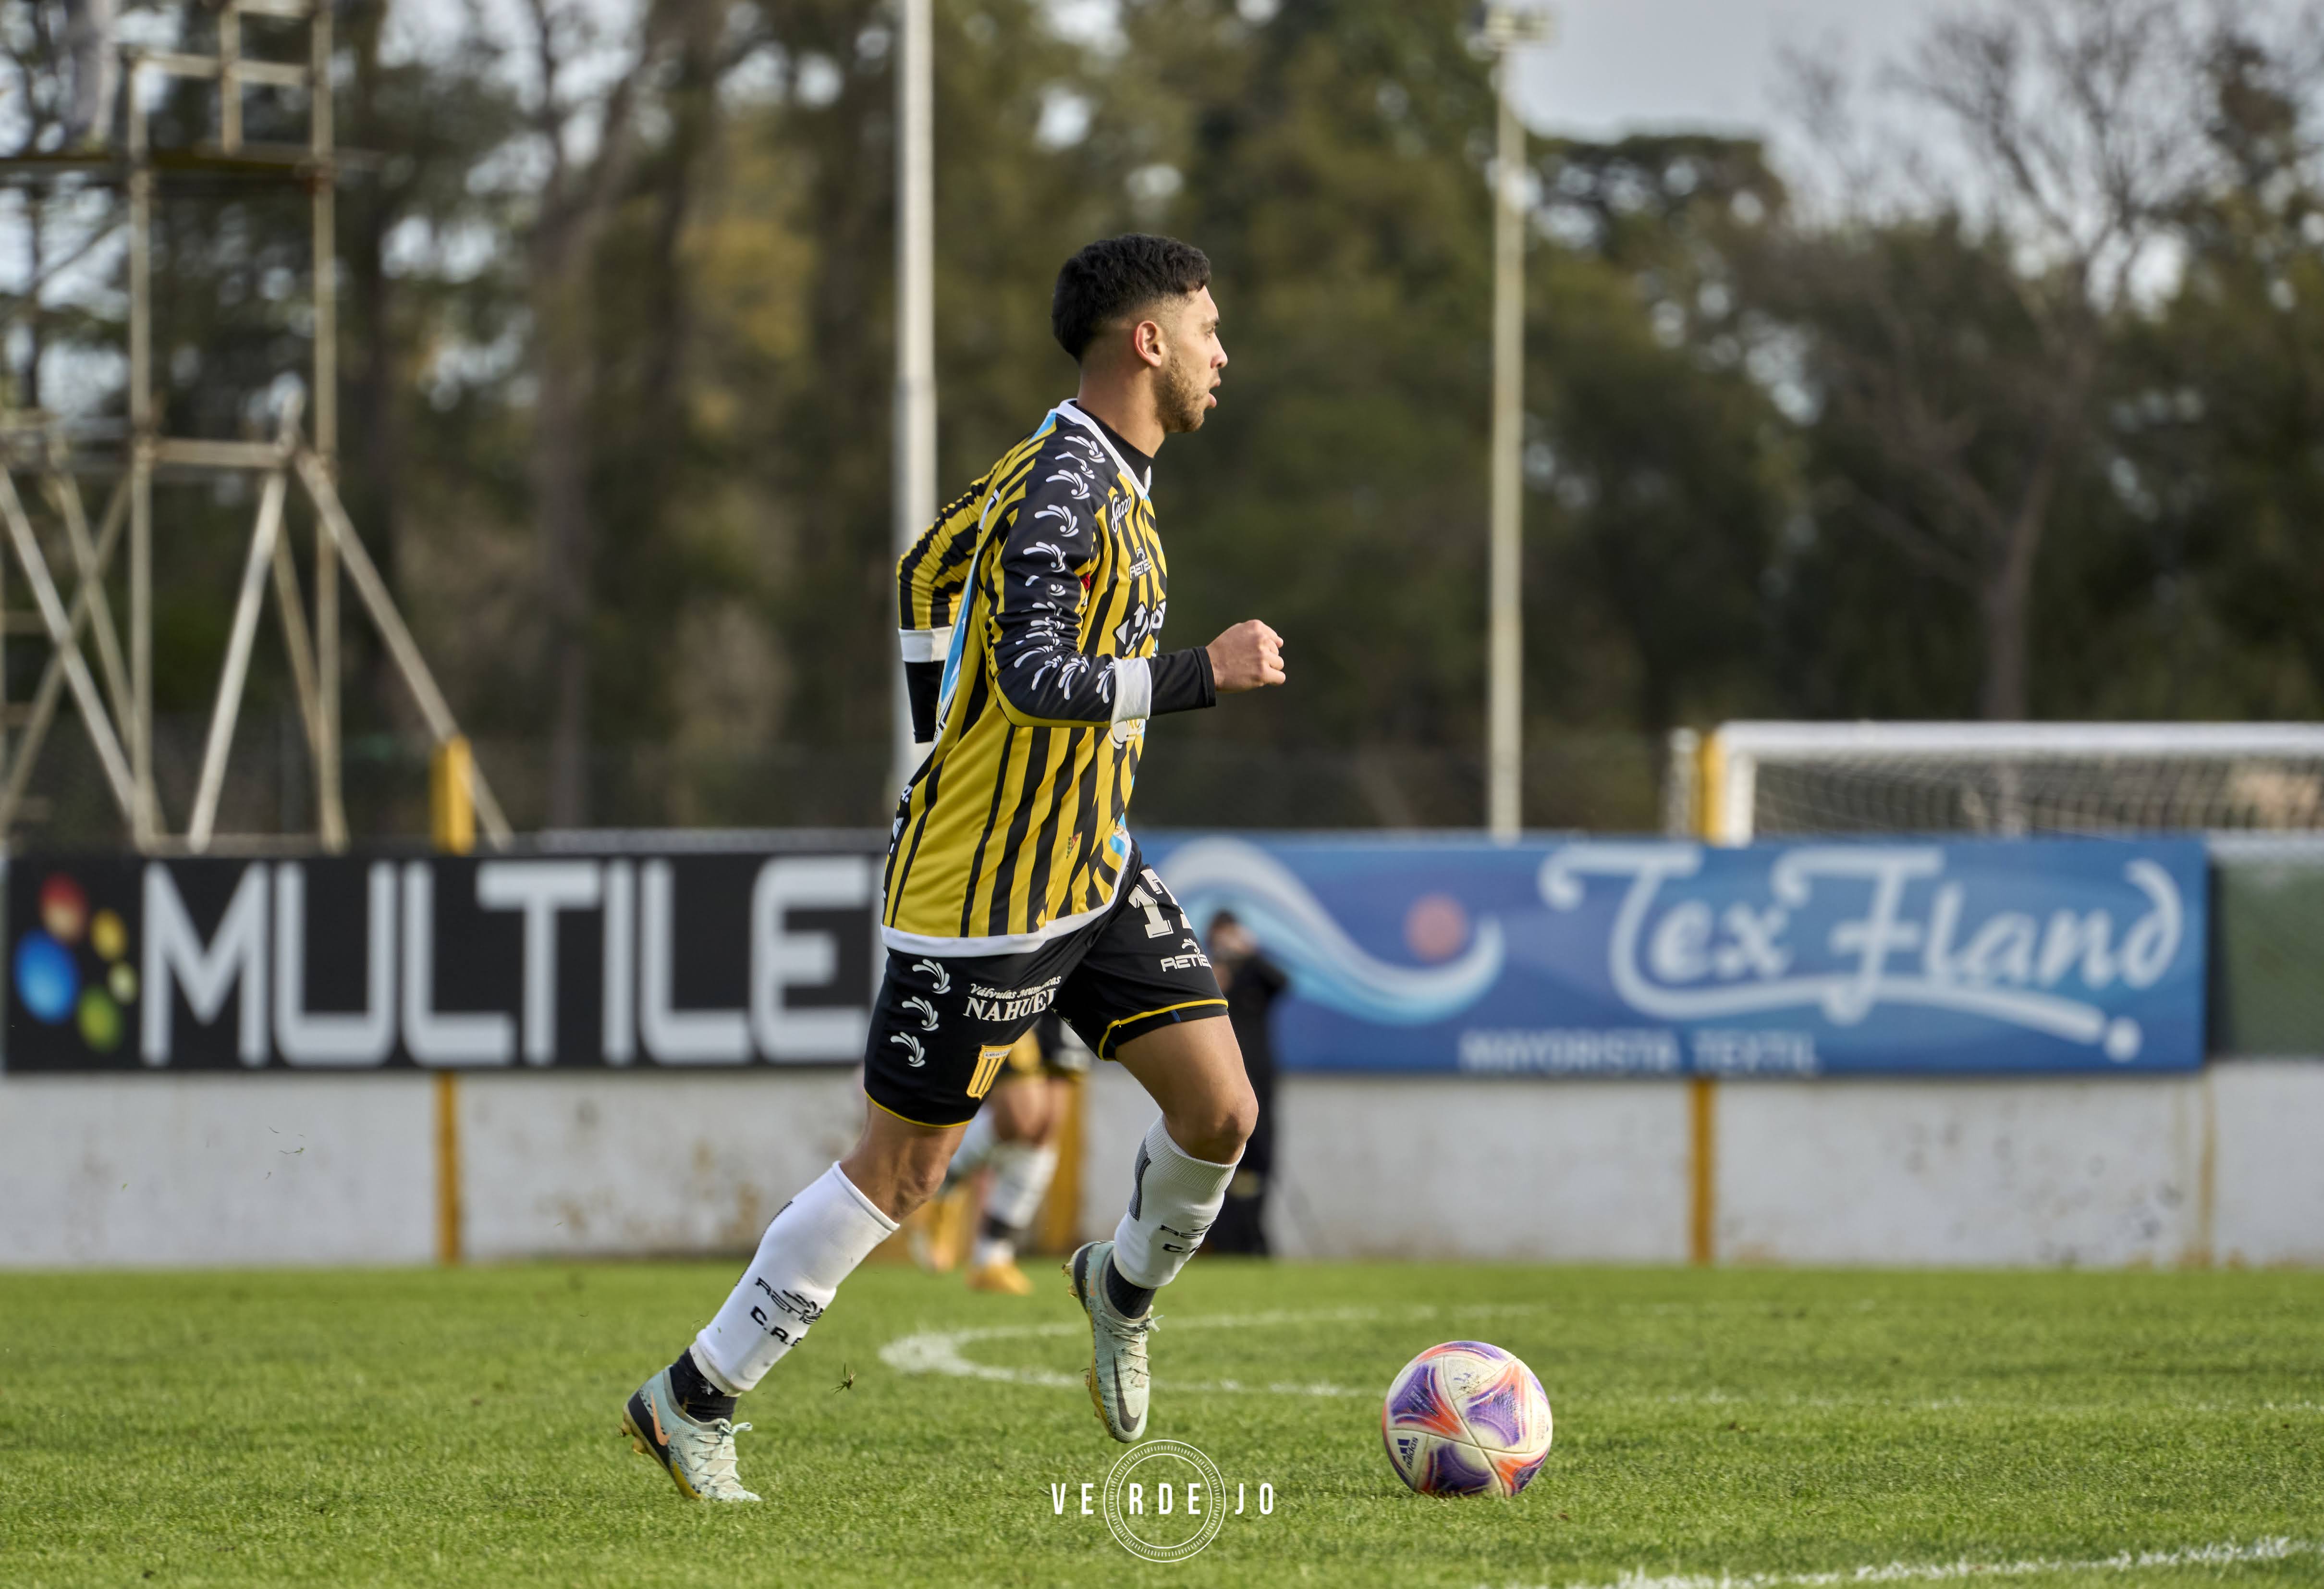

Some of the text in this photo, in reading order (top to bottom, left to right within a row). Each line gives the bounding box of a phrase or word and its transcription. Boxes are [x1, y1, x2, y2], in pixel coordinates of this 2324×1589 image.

[1111, 496, 1132, 533] Secco
[1128, 868, 1193, 939] 17
[1538, 845, 1793, 1020] Tex
[140, 856, 887, 1065] MULTILE
[1406, 1437, 1419, 1469] adidas
